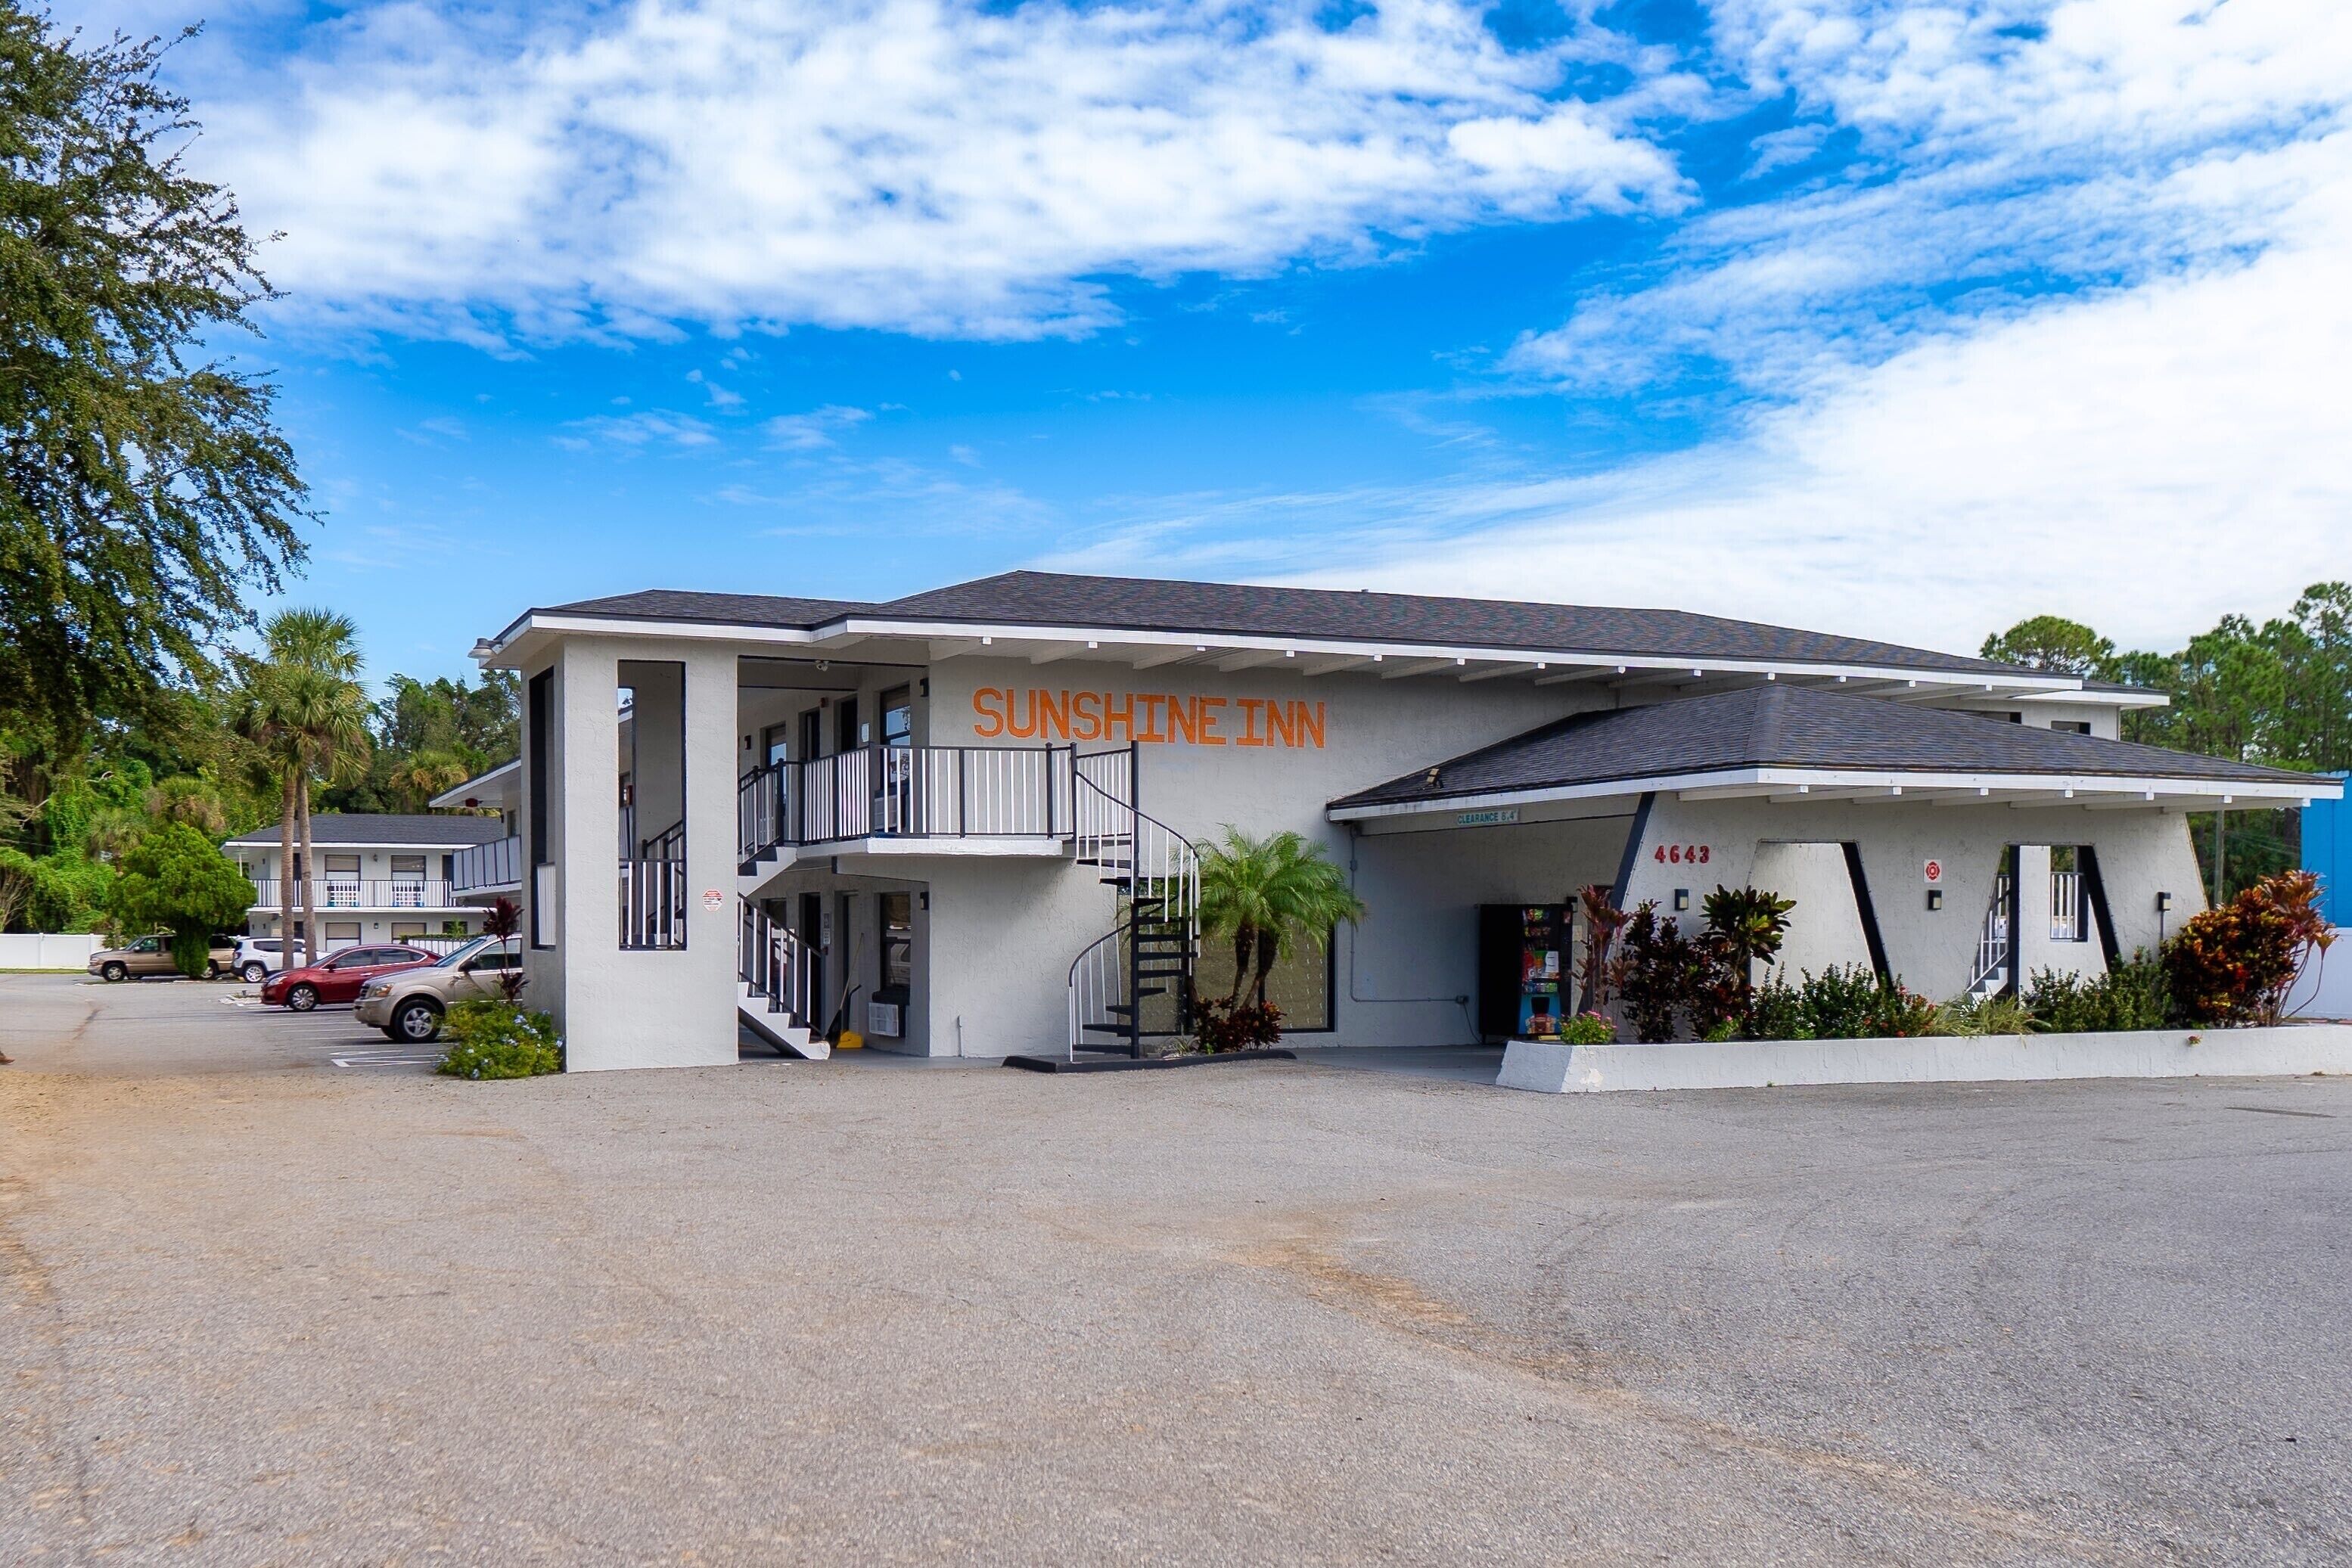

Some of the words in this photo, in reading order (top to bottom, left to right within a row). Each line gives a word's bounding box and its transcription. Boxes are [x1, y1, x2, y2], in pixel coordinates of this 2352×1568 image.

[973, 688, 1227, 744] SUNSHINE
[1236, 698, 1325, 748] INN
[1458, 812, 1499, 824] CLEARANCE
[1654, 845, 1710, 863] 4643
